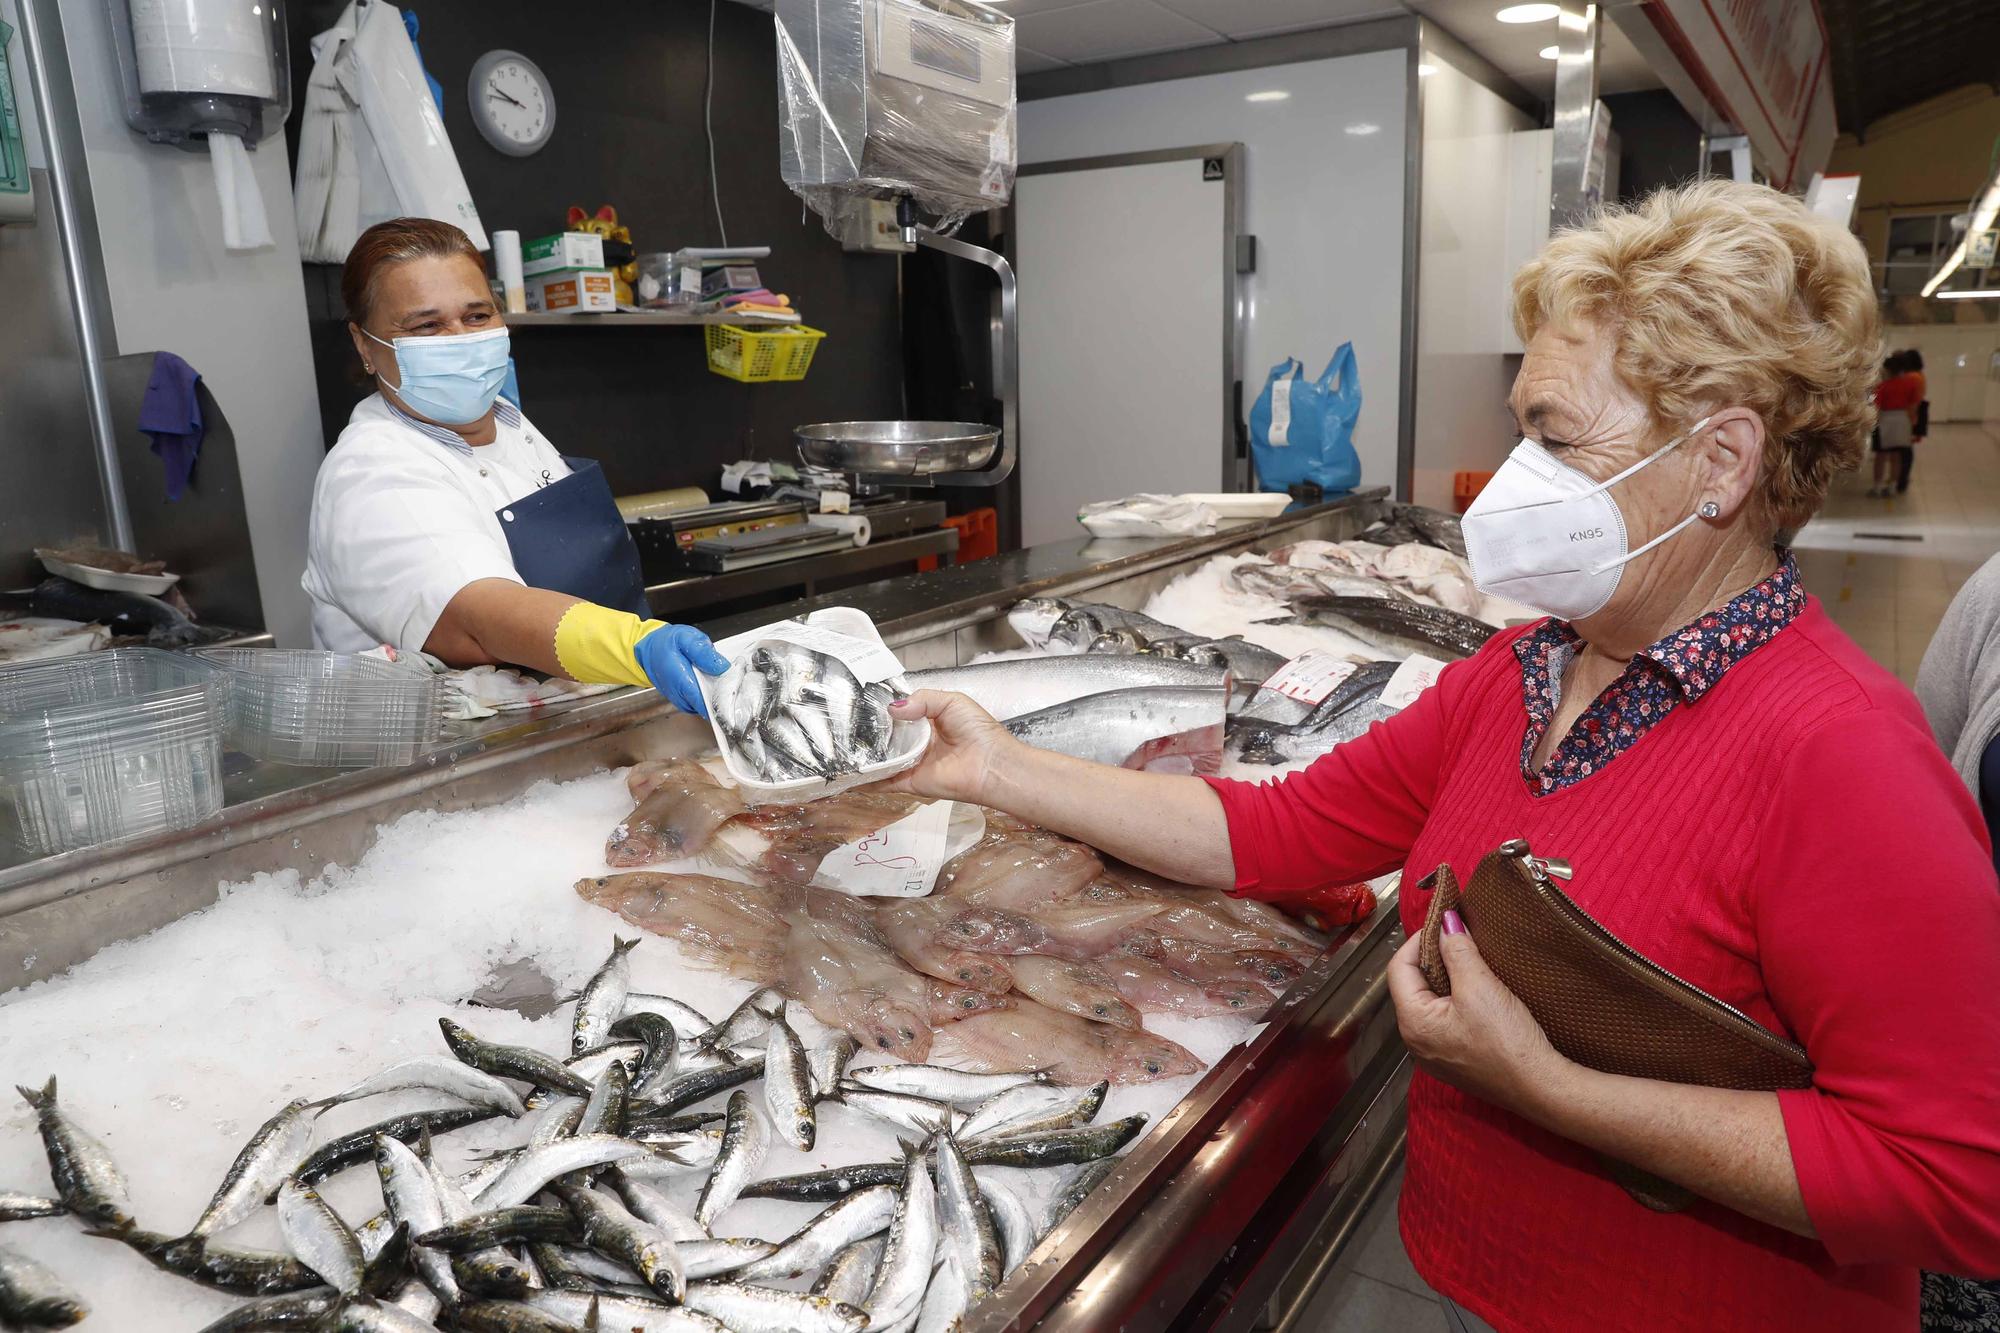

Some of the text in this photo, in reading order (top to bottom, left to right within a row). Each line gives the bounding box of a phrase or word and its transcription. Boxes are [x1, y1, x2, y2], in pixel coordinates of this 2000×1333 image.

[497, 69, 504, 79] 11
[508, 66, 517, 77] 12
[533, 86, 538, 97] 2
[1569, 527, 1604, 543] KN95
